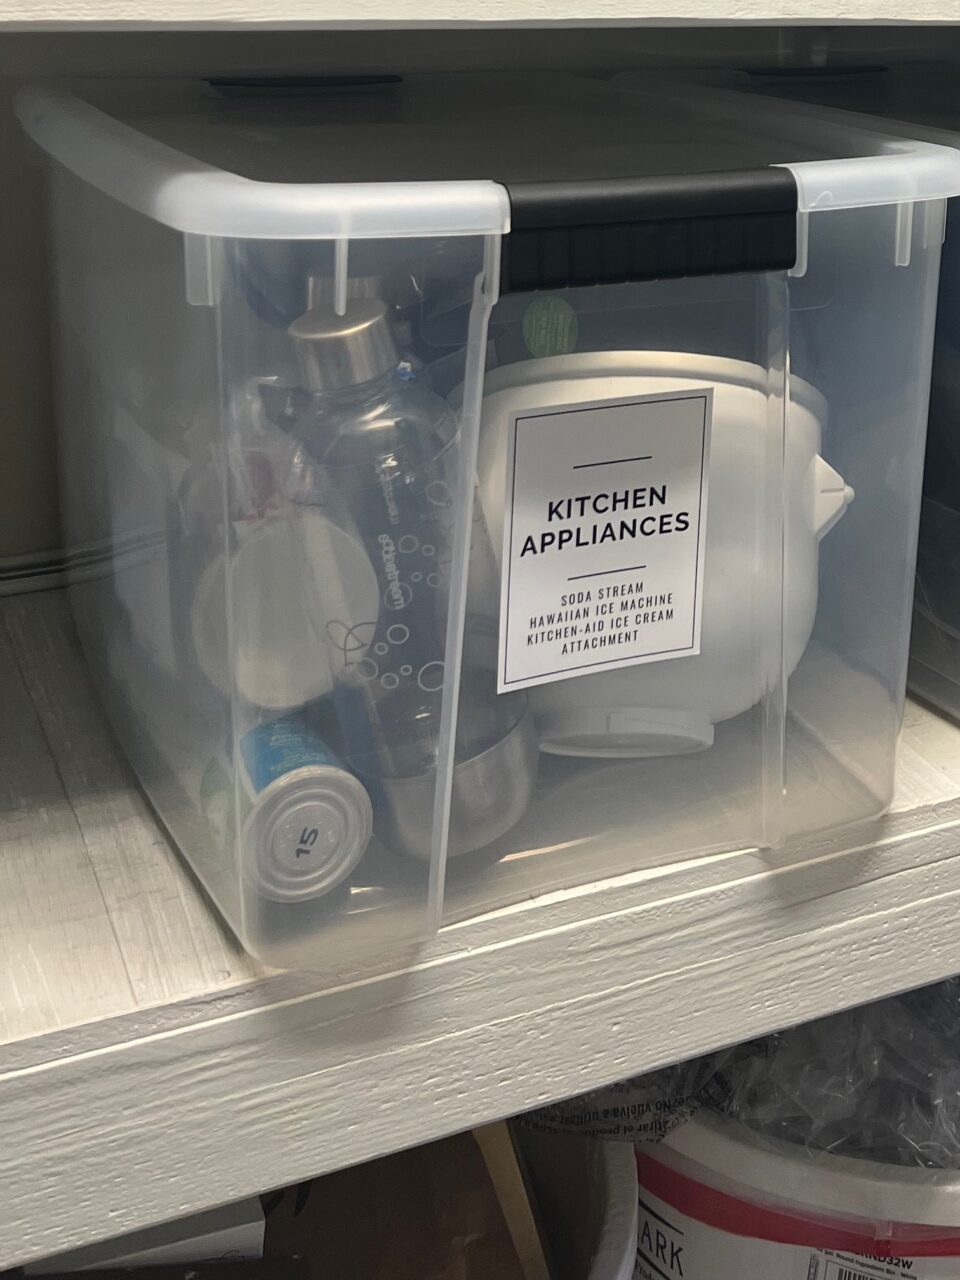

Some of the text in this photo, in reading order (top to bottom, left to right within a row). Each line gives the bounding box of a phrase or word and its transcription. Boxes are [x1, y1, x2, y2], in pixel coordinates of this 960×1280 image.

[548, 485, 668, 522] KITCHEN
[520, 512, 690, 557] APPLIANCES
[530, 593, 673, 629] HAWAIIAN ICE MACHINE
[561, 582, 644, 607] SODA STREAM
[527, 609, 675, 646] KITCHEN-AID ICE CREAM
[562, 631, 640, 655] ATTACHMENT
[295, 826, 319, 859] 15
